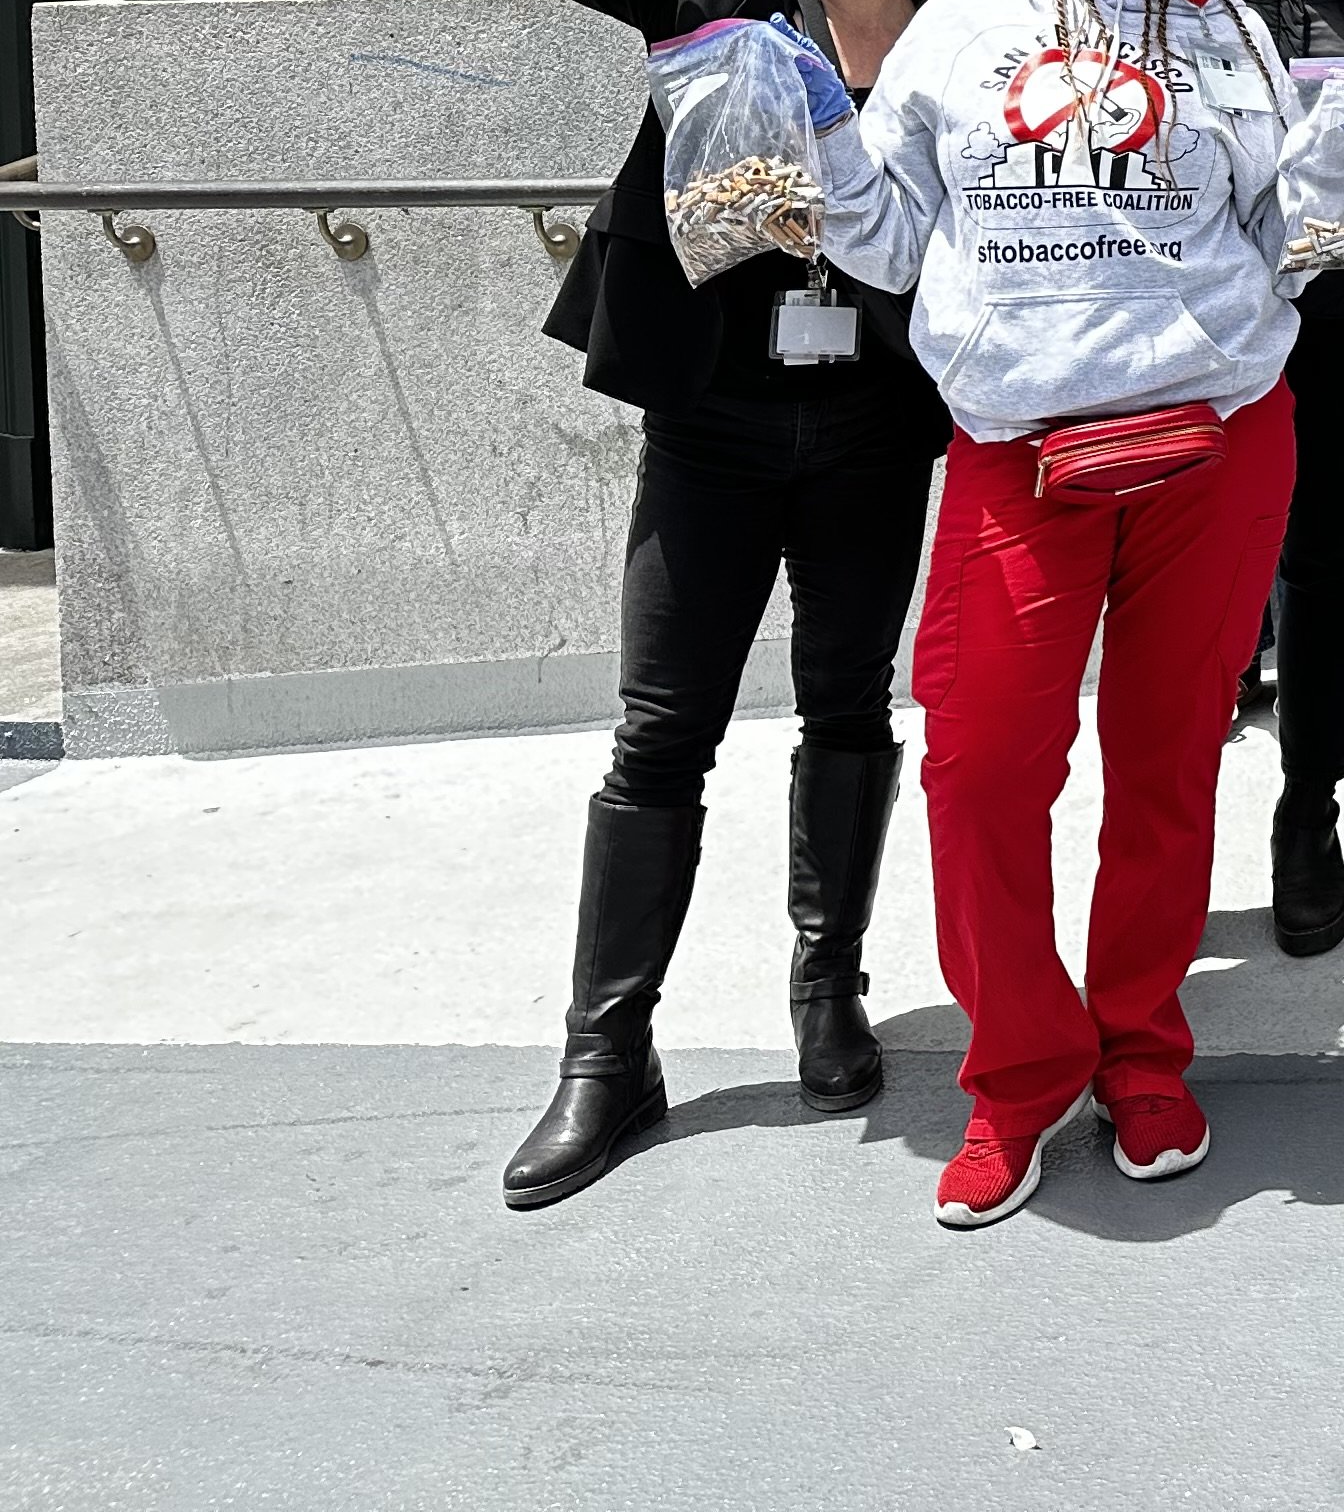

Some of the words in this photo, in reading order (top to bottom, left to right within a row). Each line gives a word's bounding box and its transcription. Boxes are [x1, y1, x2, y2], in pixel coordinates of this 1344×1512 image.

[980, 47, 1030, 91] SAN
[966, 191, 1098, 211] TOBACCO-FREE
[1103, 192, 1193, 211] COALITION
